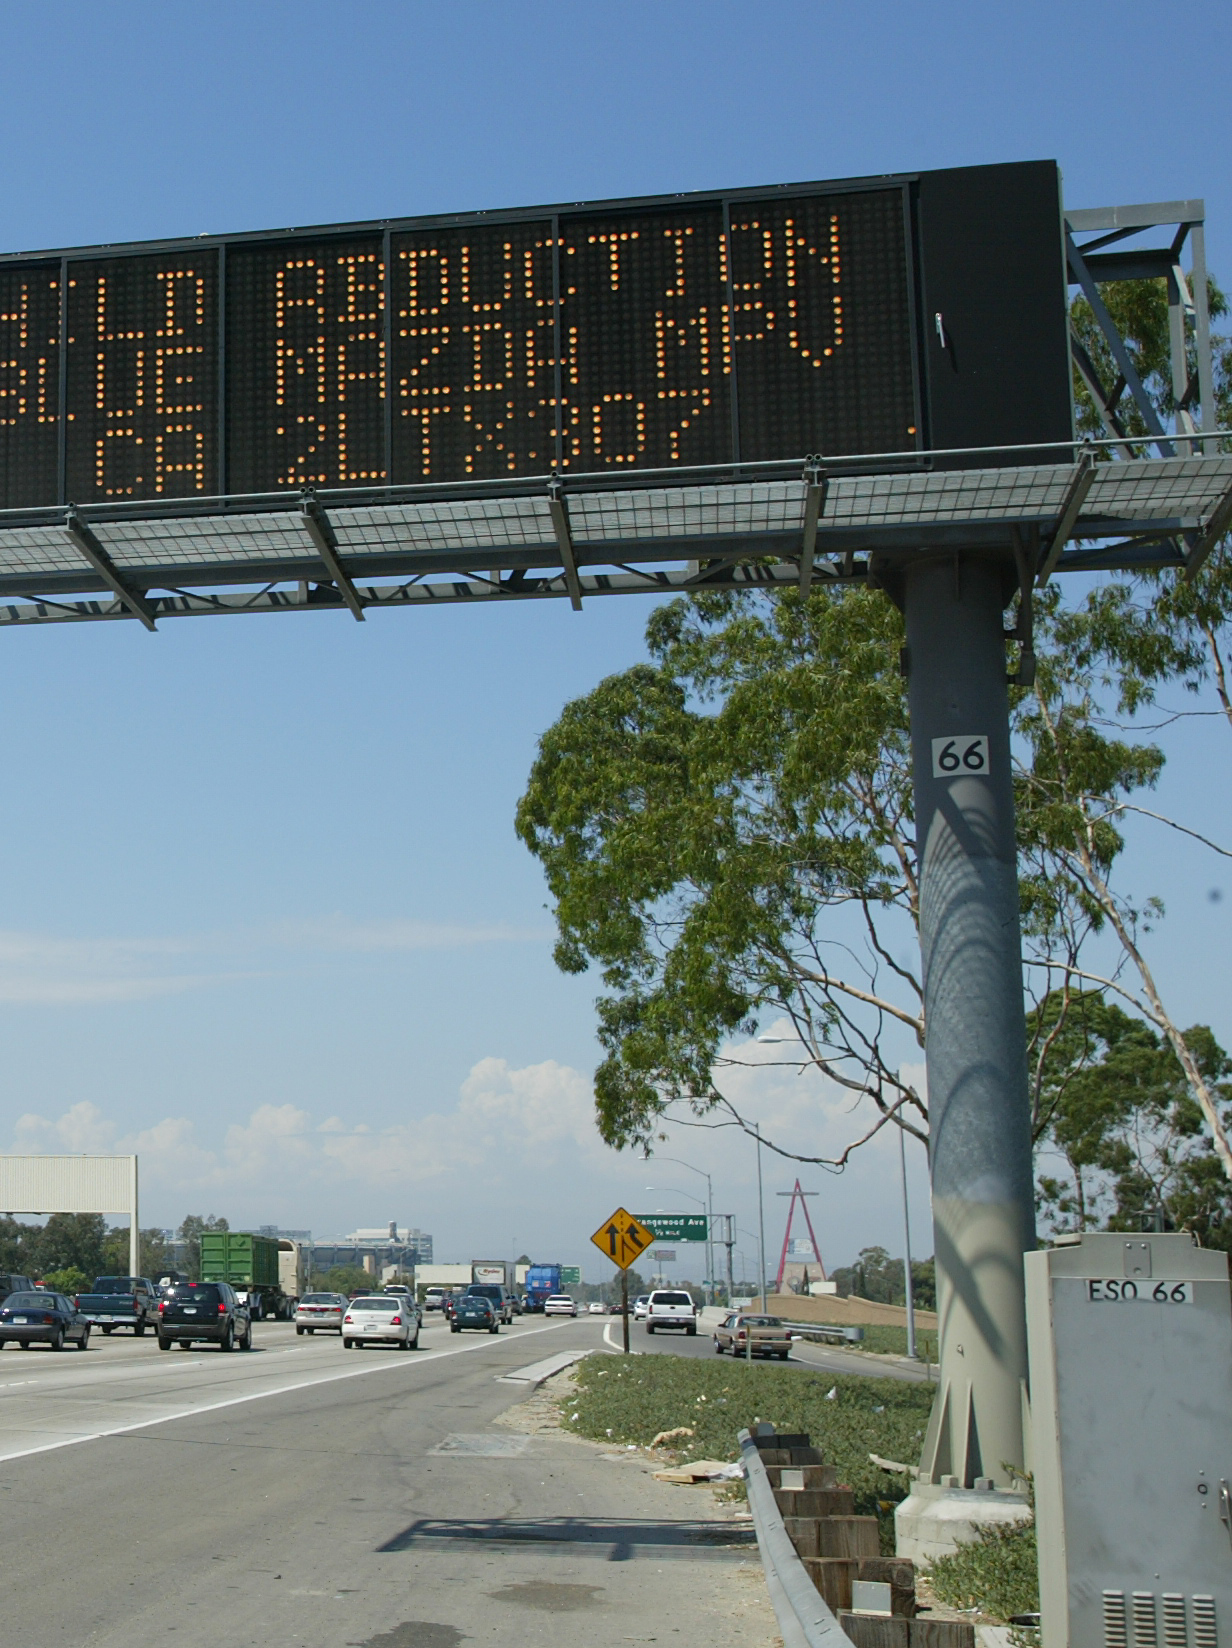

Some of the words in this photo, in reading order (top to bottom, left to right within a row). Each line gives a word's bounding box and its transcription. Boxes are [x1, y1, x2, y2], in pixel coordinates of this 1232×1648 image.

[276, 214, 841, 328] ABDUCTION
[276, 317, 579, 405] MAZDA
[655, 296, 843, 380] MPV
[95, 423, 204, 496] CA
[938, 740, 984, 771] 66
[637, 1218, 684, 1227] angewood
[688, 1218, 705, 1226] Ave
[1153, 1281, 1185, 1303] 66
